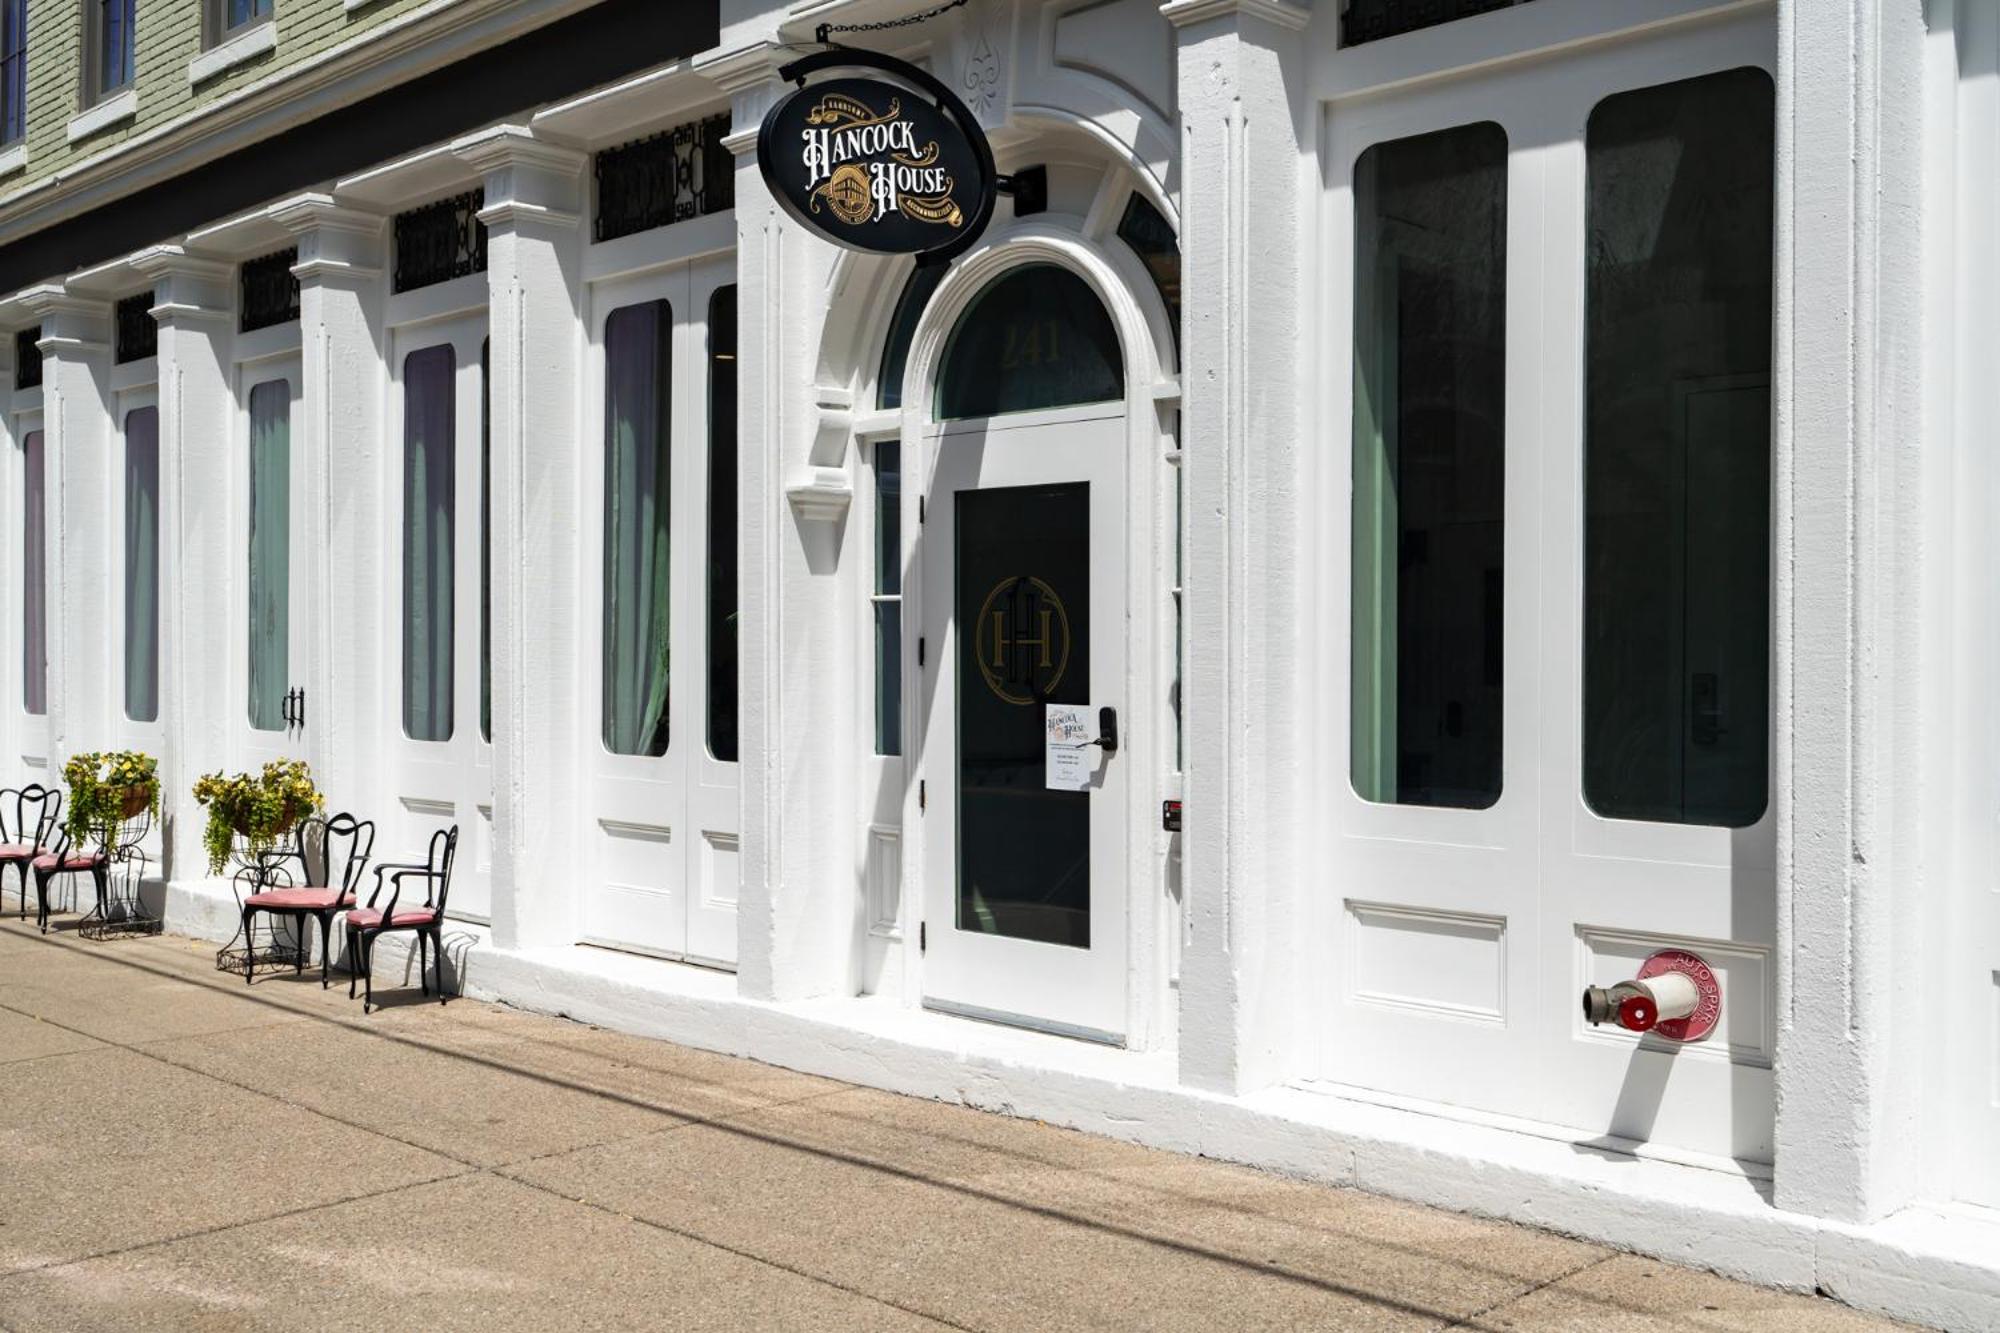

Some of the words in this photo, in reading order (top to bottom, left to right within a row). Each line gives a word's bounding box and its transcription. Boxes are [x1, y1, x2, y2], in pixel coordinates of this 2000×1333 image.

[802, 121, 923, 191] HANCOCK
[870, 162, 947, 222] HOUSE
[1676, 954, 1711, 979] AUTO
[1703, 985, 1719, 1025] SPKR
